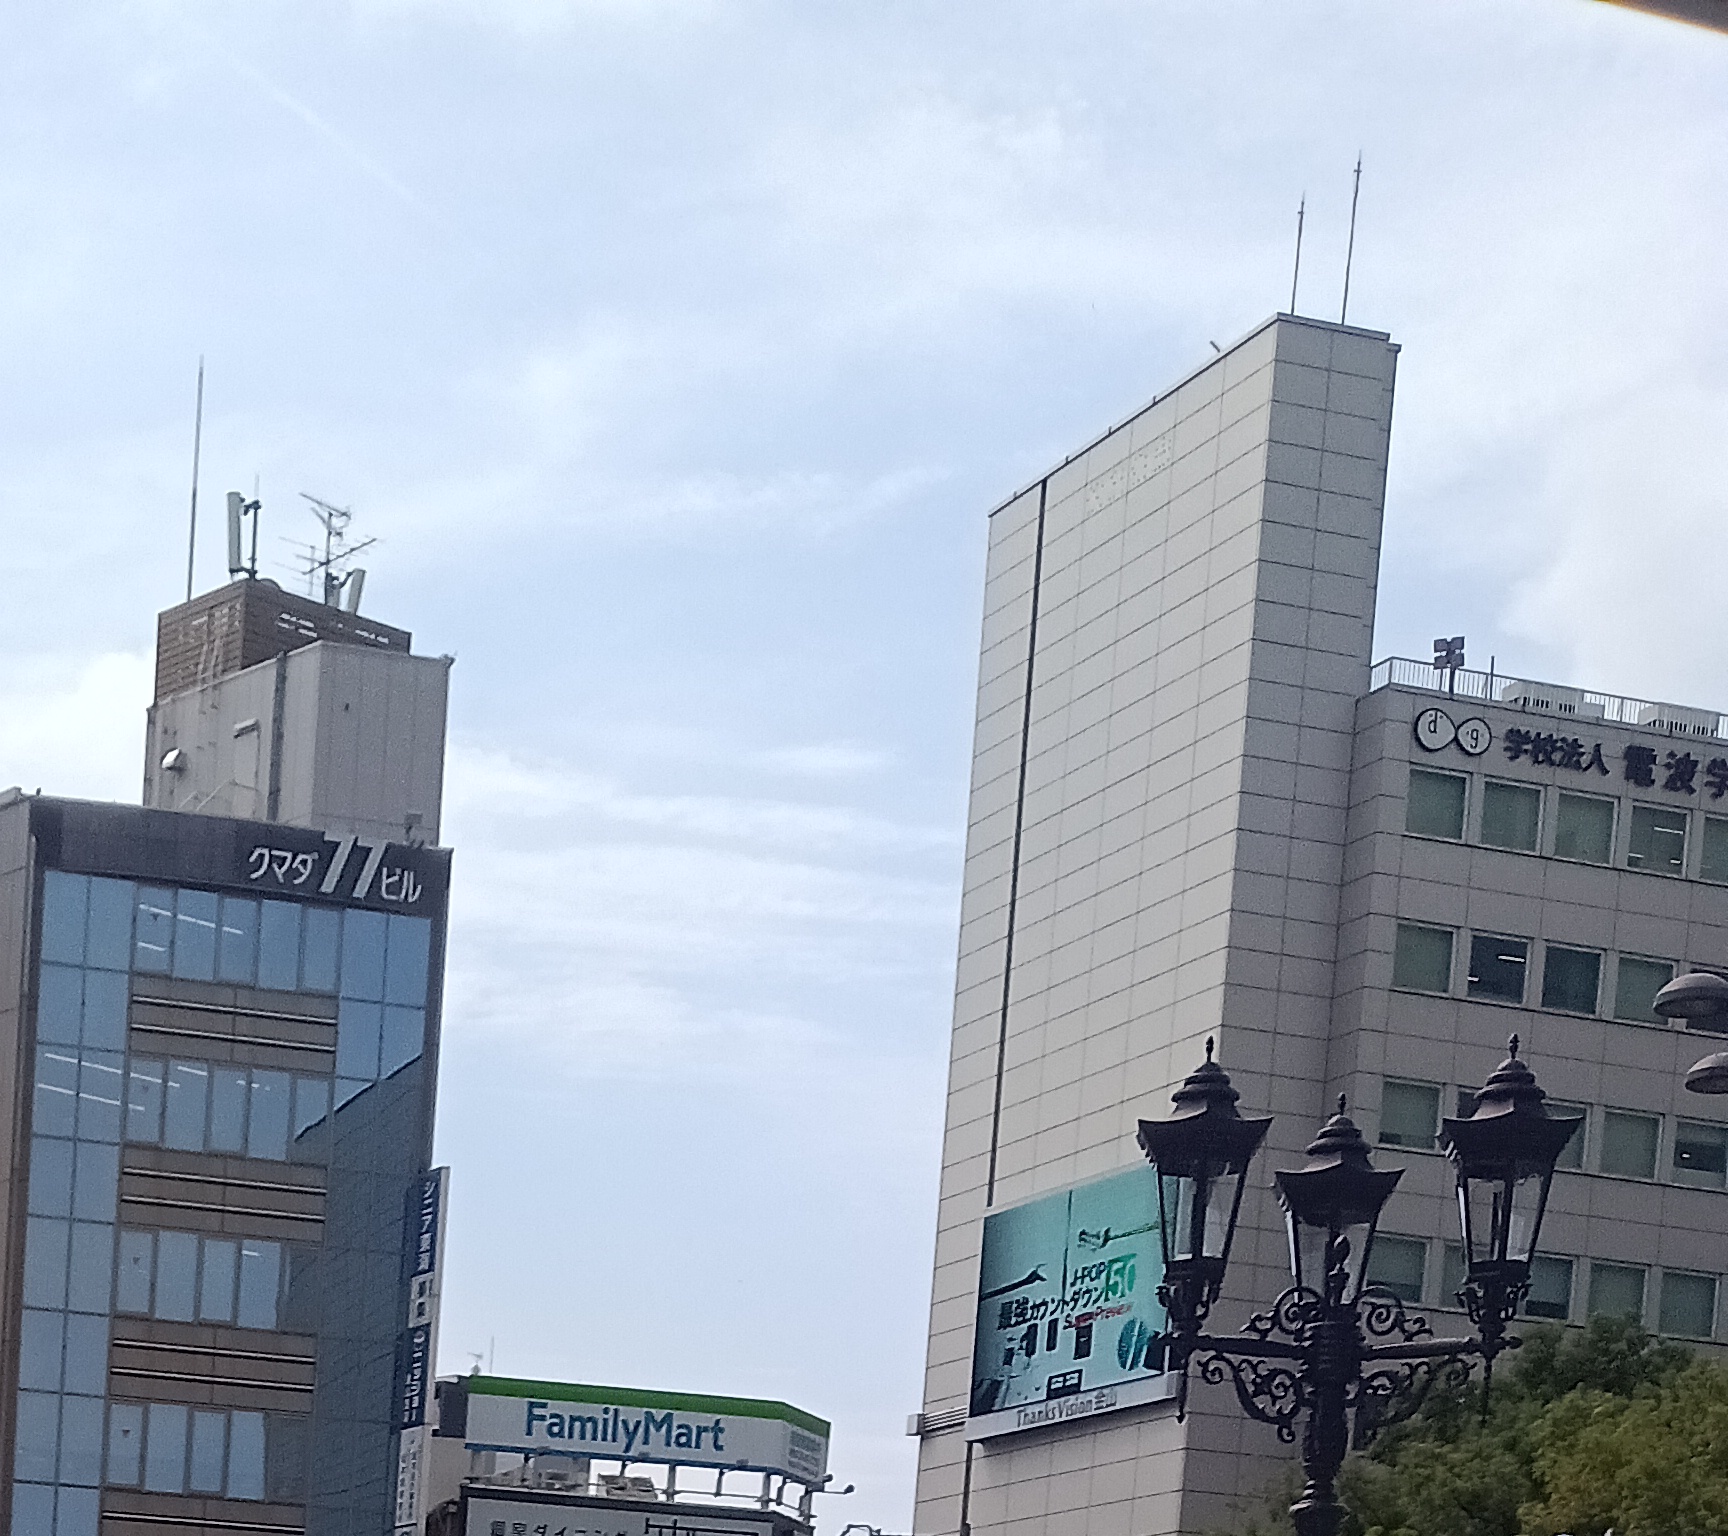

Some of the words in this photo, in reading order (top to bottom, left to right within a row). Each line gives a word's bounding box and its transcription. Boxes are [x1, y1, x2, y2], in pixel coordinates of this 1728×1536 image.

[1503, 728, 1610, 776] 学校法人
[524, 1400, 726, 1453] FamilyMart
